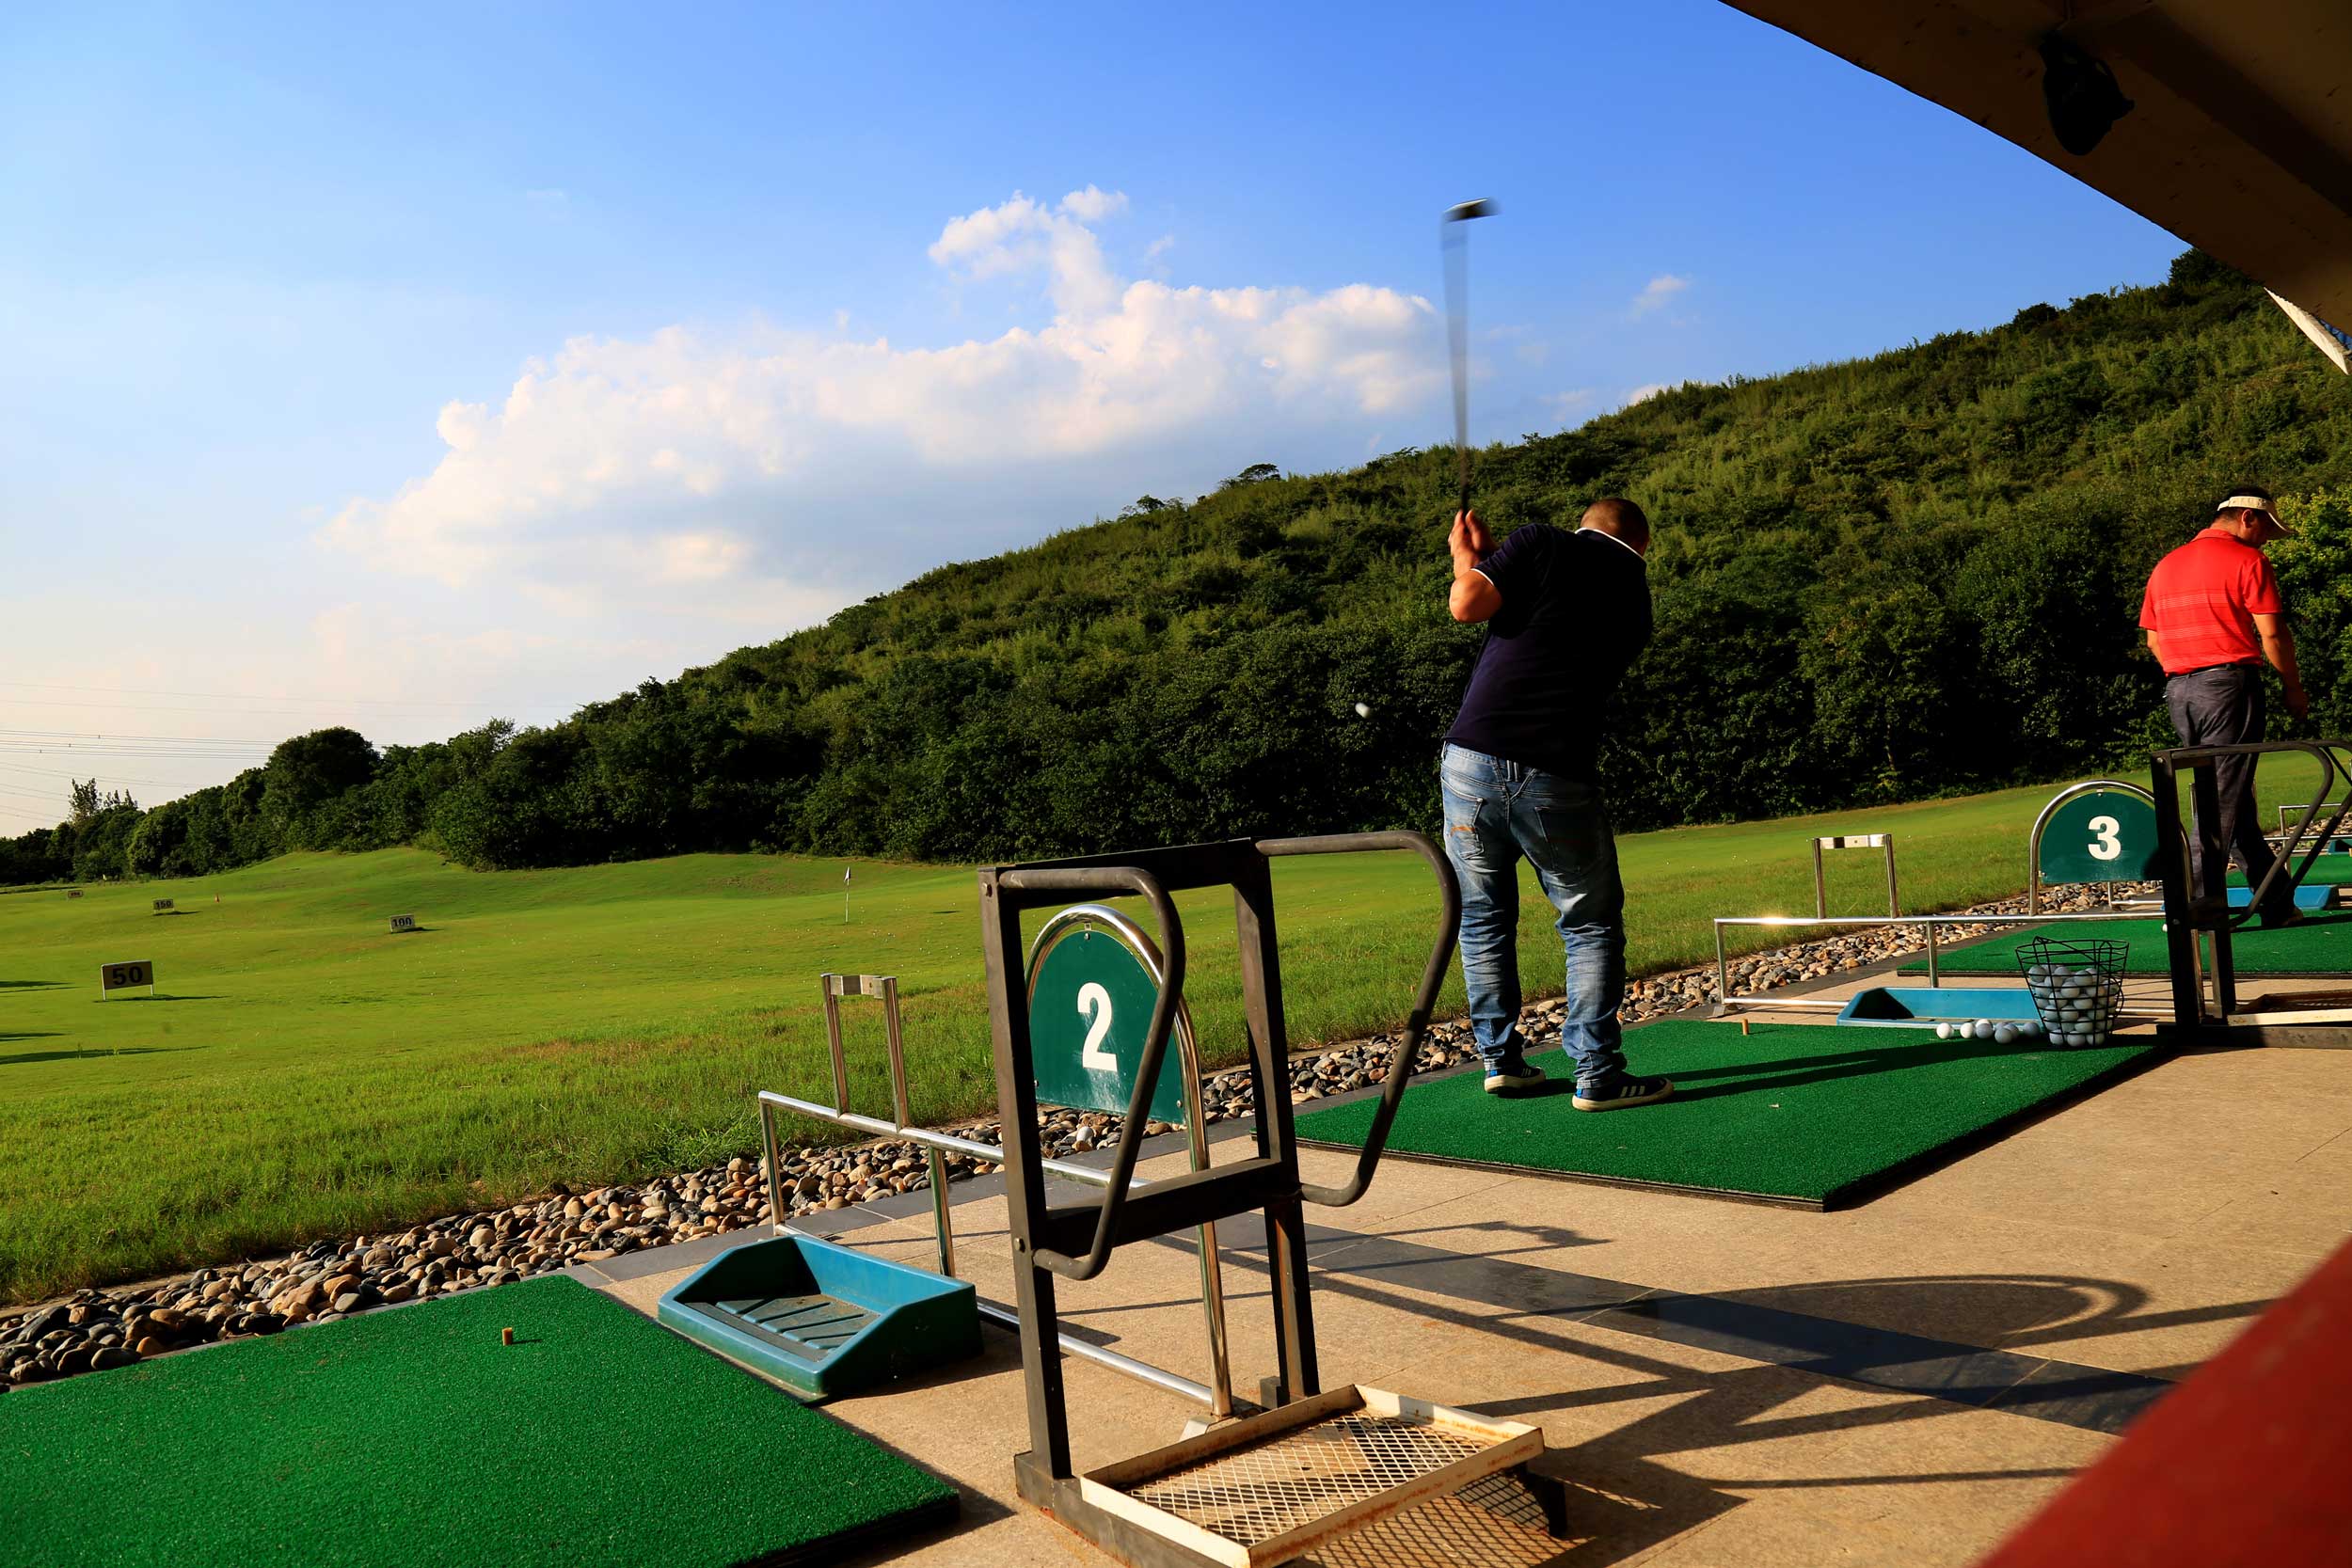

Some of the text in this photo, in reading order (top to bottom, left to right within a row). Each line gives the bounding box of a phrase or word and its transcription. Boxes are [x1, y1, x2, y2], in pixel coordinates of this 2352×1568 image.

[2087, 816, 2122, 861] 3
[155, 900, 172, 910] 150
[392, 917, 412, 927] 100
[112, 966, 143, 986] 50
[1077, 982, 1118, 1072] 2
